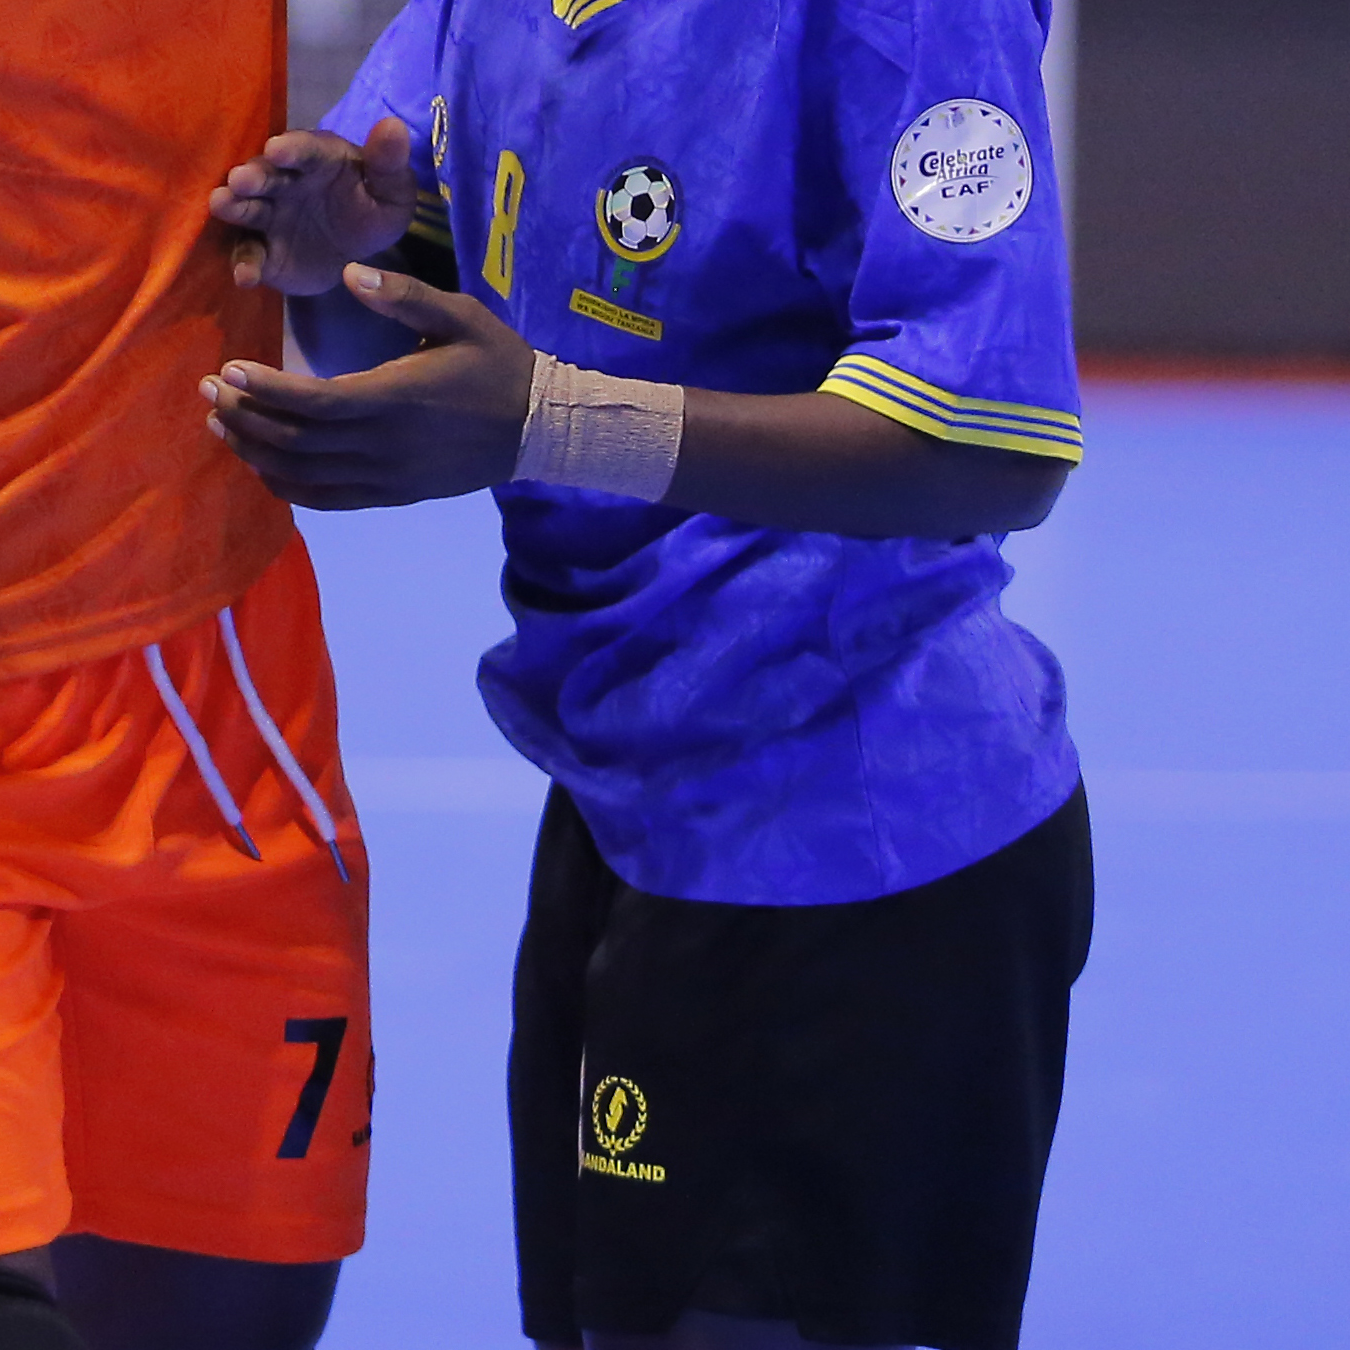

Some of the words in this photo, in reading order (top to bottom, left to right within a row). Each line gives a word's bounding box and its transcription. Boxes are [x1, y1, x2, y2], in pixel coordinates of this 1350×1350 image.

[919, 145, 1004, 177] Celebrate
[941, 180, 990, 199] CAF
[481, 150, 526, 300] 8
[276, 1016, 347, 1158] 7
